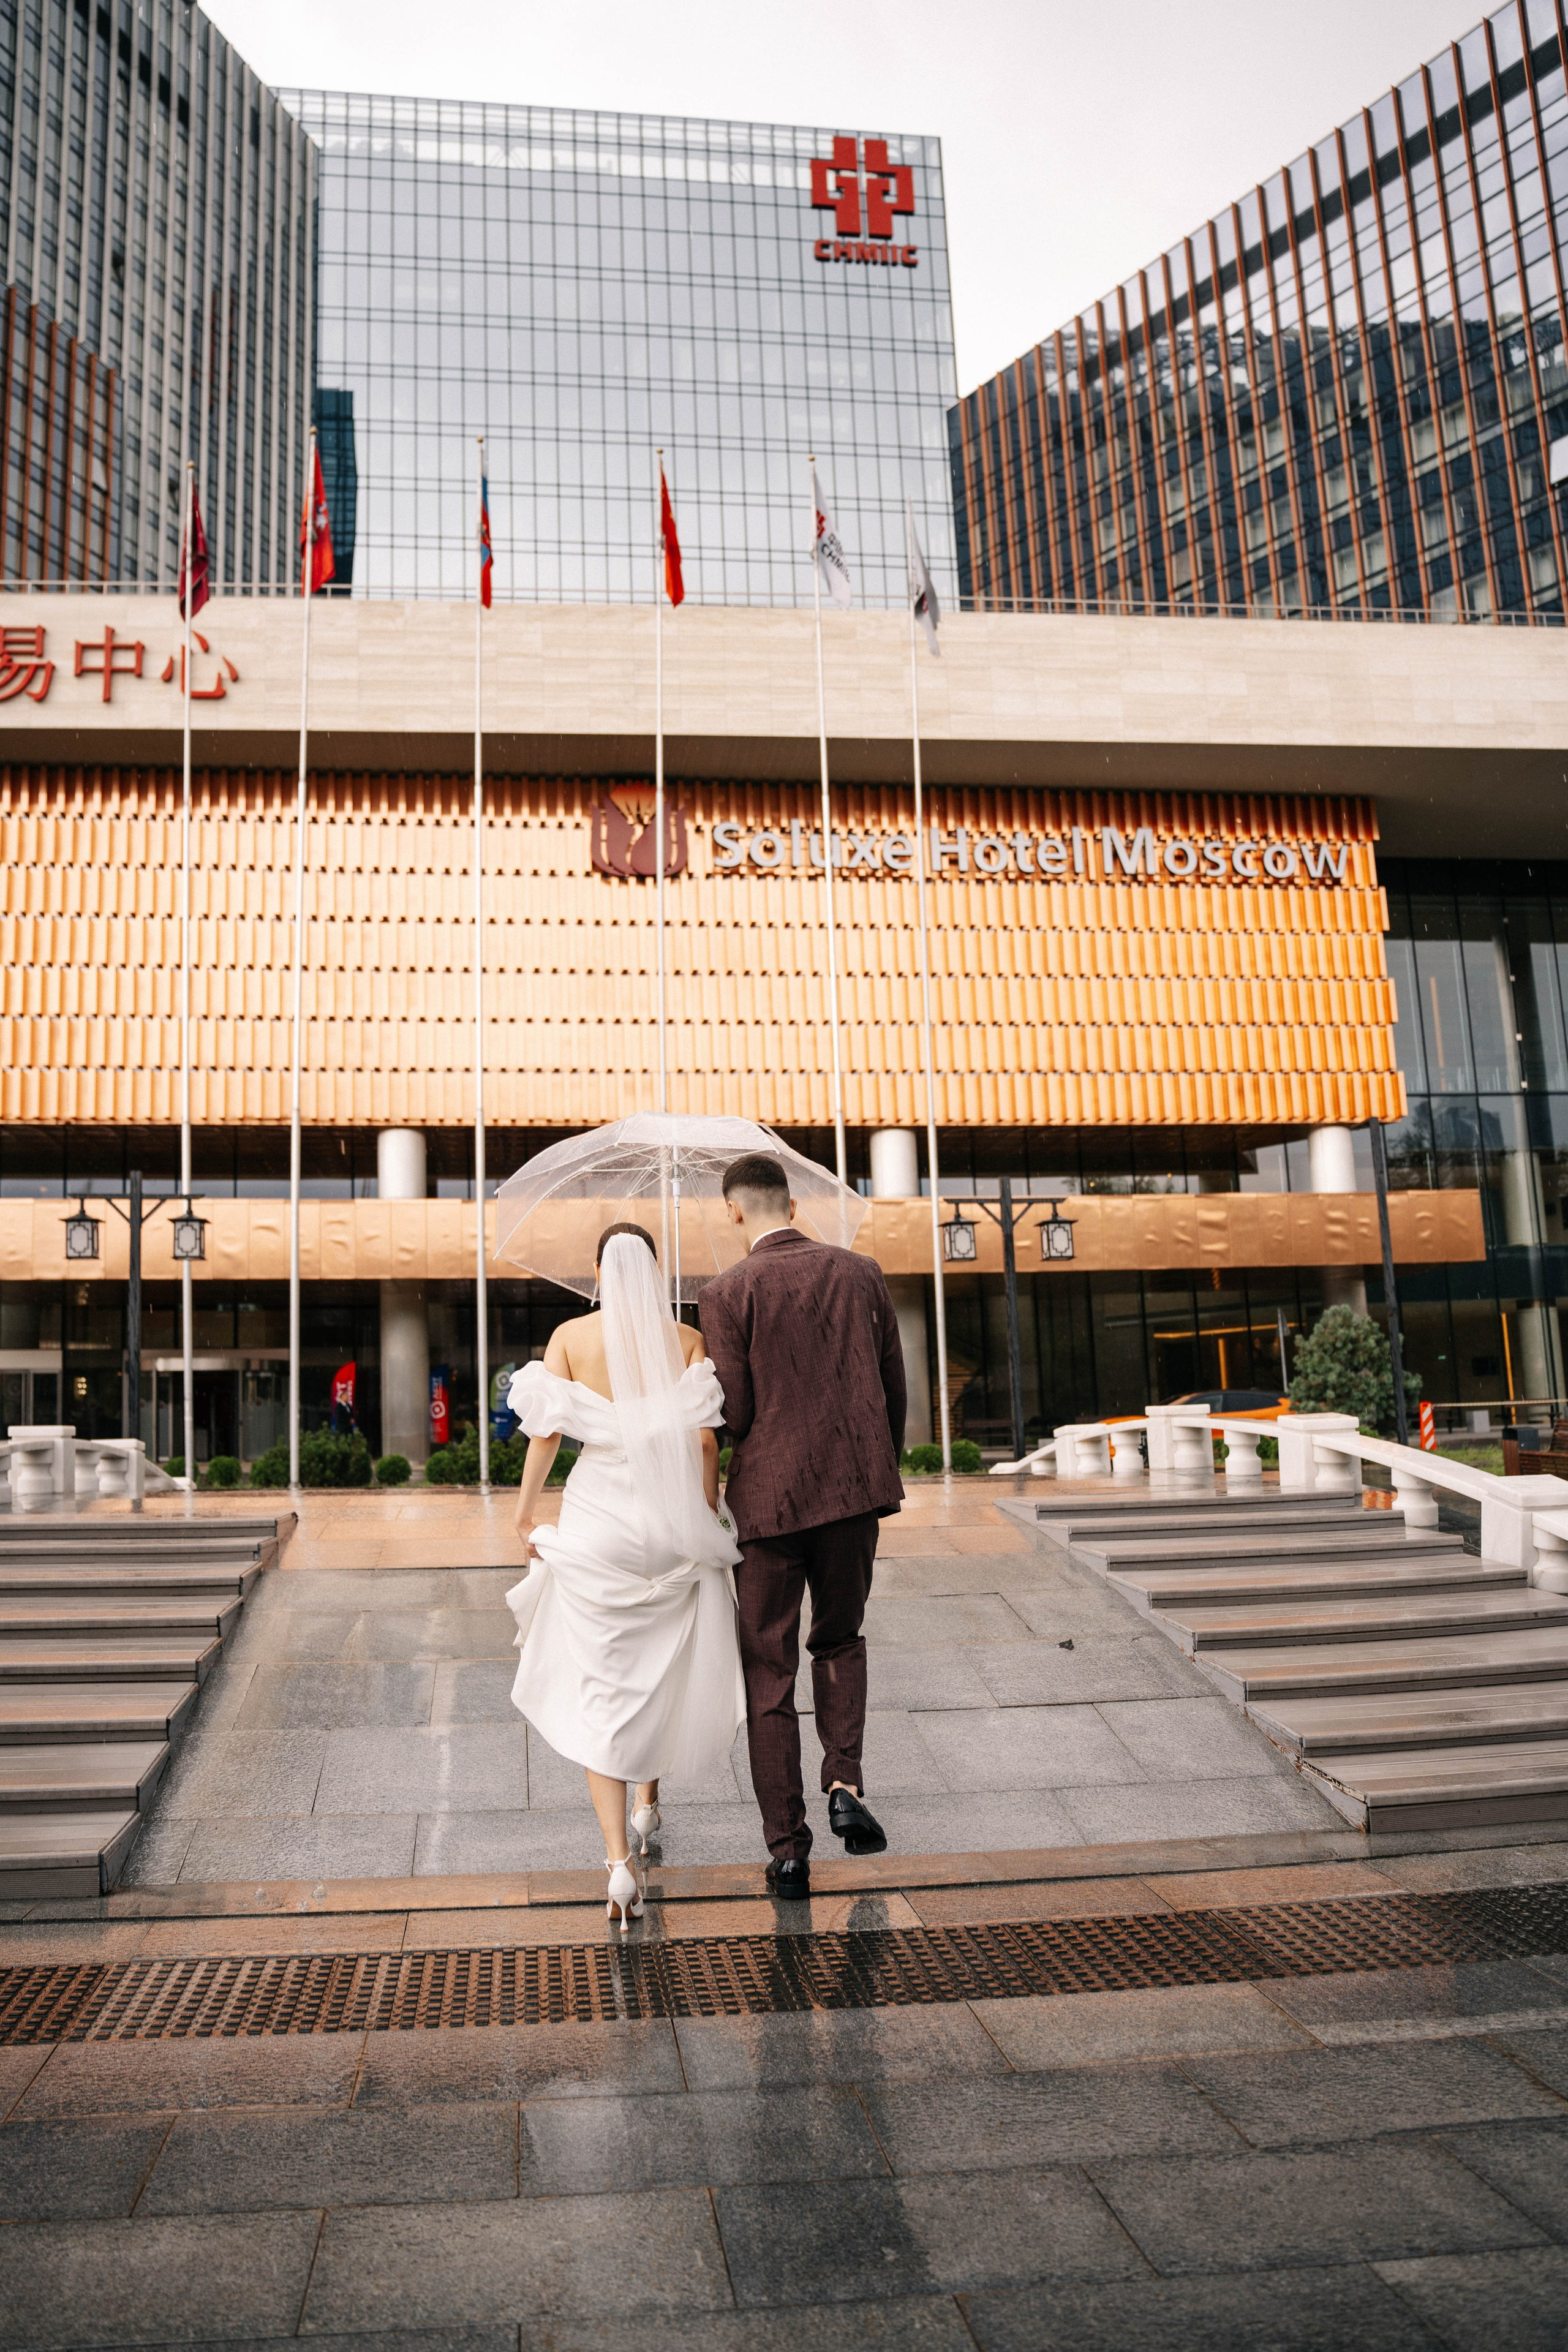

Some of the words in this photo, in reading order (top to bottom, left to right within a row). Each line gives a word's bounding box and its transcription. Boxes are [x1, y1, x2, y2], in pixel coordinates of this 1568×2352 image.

[814, 239, 918, 267] CHMIIC
[0, 625, 239, 702] 易中心
[713, 818, 913, 870] Soluxe
[929, 826, 1085, 874] Hotel
[1102, 827, 1348, 879] Moscow
